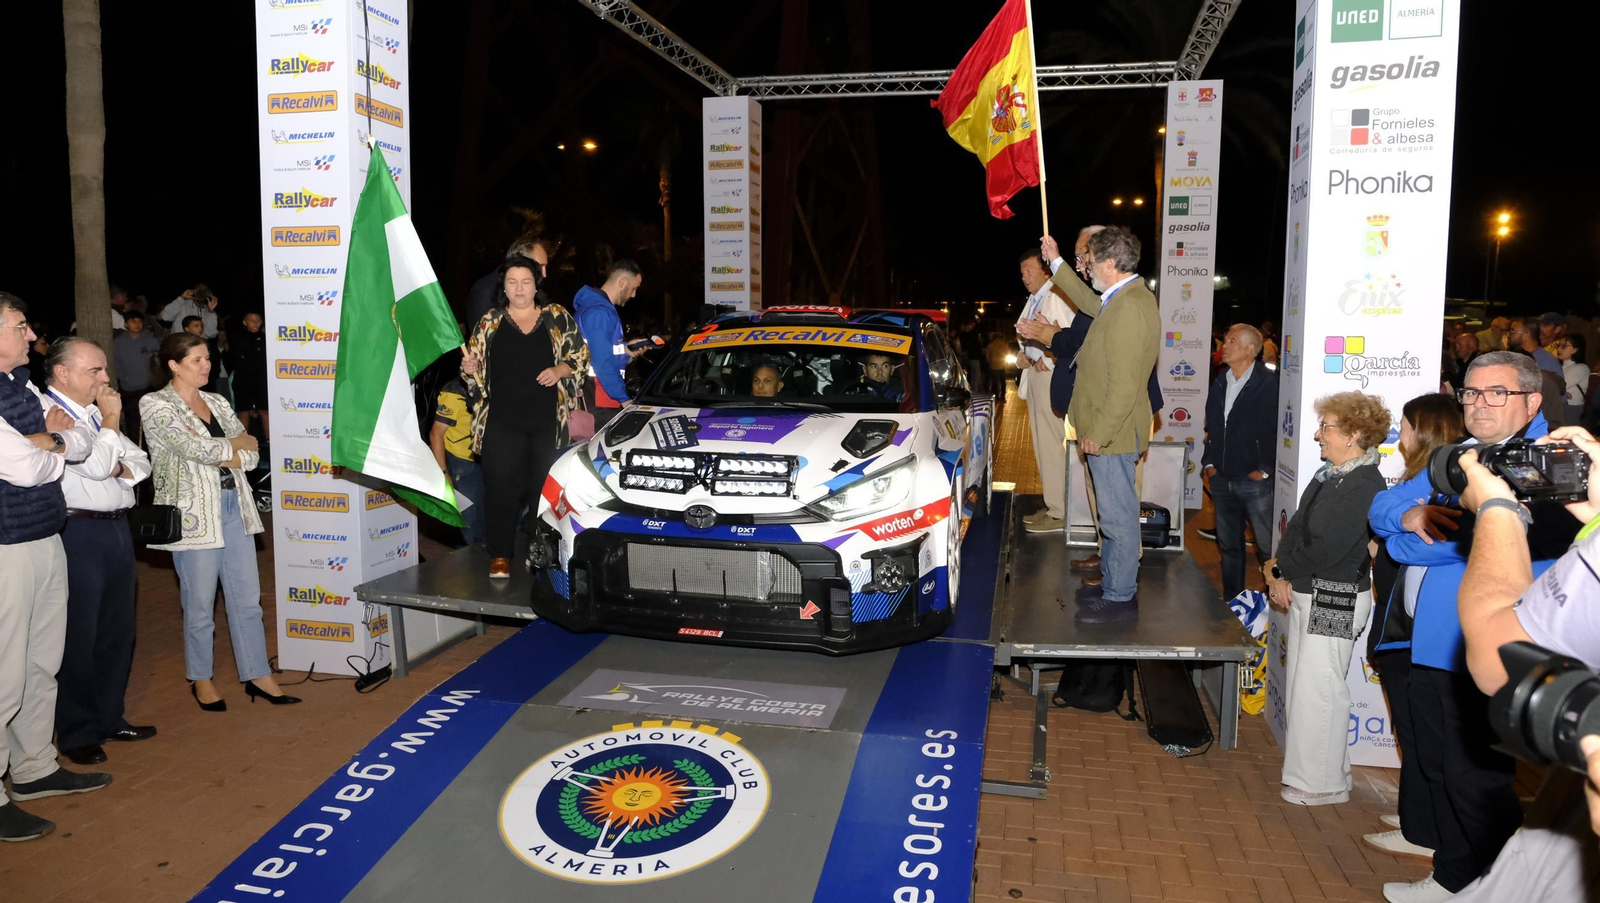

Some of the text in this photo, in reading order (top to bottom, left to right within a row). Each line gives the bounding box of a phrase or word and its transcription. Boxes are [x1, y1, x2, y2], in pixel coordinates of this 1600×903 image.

[367, 5, 400, 25] MICHELIN
[1336, 10, 1378, 25] UNED
[271, 58, 334, 73] Rallycar
[1330, 55, 1440, 89] gasolia
[281, 95, 324, 110] Recalvi
[1373, 108, 1400, 116] Grupo
[1372, 118, 1434, 130] Fornieles
[288, 132, 335, 140] MICHELIN
[1372, 132, 1434, 145] & albesa
[1170, 176, 1212, 187] MOVA
[1328, 169, 1433, 195] Phonika
[275, 193, 337, 208] Rallycar
[1168, 222, 1210, 234] gasolia
[285, 229, 326, 243] Recalvi
[1168, 265, 1208, 276] Phonika
[767, 305, 844, 313] worten
[692, 324, 719, 341] 2
[743, 329, 847, 342] Recalvi
[289, 363, 330, 376] Recalvi
[1344, 351, 1420, 389] garcía
[295, 495, 336, 508] Recalvi
[380, 522, 410, 536] MICHELIN
[872, 516, 914, 536] worten
[302, 532, 347, 542] MICHELIN
[288, 587, 350, 606] Rallycar
[299, 625, 340, 638] Recalvi
[662, 691, 826, 711] RALLYE COSTA
[680, 700, 823, 717] DE ALMERIA
[550, 731, 759, 791] AUTOMOVIL CLUB
[217, 690, 481, 903] www.garciai
[528, 844, 671, 876] ALMERIA
